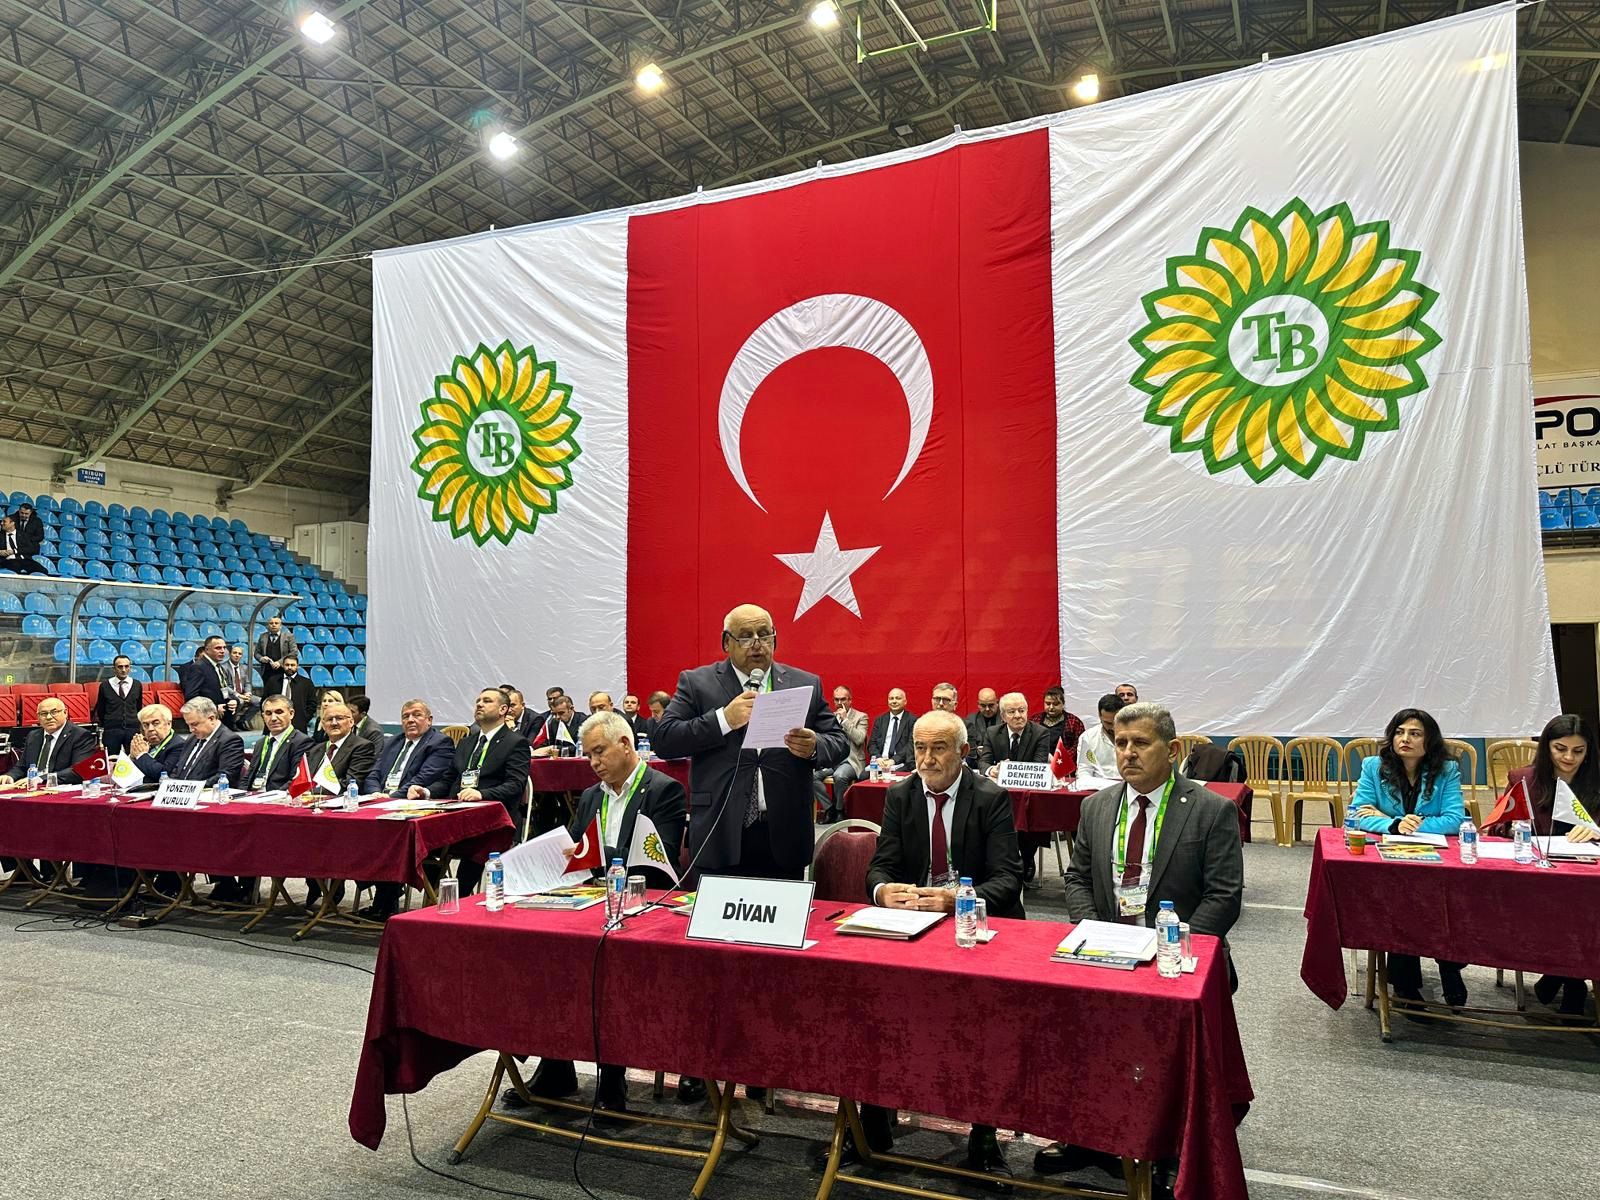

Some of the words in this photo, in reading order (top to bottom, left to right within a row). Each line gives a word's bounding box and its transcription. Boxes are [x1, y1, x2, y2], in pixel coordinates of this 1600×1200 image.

[1241, 311, 1319, 373] TB
[474, 422, 515, 467] TB
[165, 781, 197, 794] YÖNETİM
[160, 796, 190, 806] KURULU
[722, 898, 777, 924] DİVAN
